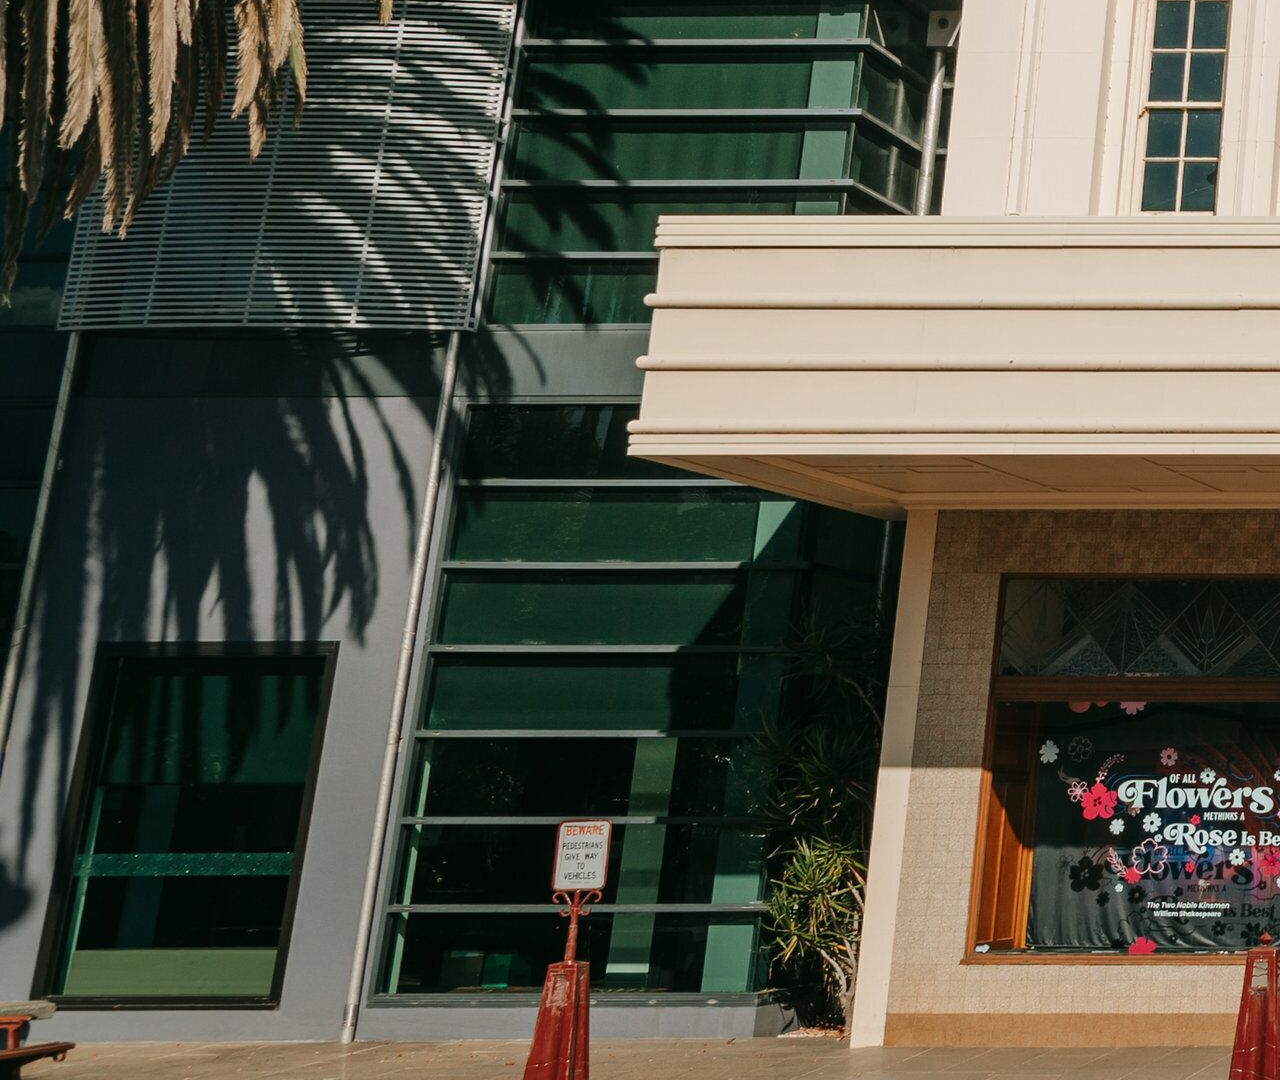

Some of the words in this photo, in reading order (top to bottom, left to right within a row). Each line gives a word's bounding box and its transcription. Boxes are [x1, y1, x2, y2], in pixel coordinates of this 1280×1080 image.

[1169, 774, 1180, 784] OF
[1182, 774, 1197, 784] ALL
[1117, 777, 1274, 814] Flowers
[1203, 812, 1238, 821] METHINKS
[1239, 812, 1245, 821] A
[566, 825, 605, 836] BEWARE
[1163, 823, 1237, 854] Rose
[1241, 831, 1256, 847] Is
[562, 841, 603, 851] PEDESTRIANS
[565, 853, 580, 861] GIVE
[585, 852, 599, 860] WAY
[577, 862, 586, 870] TO
[563, 871, 597, 880] VEHICLES
[1146, 901, 1160, 909] The
[1161, 901, 1176, 909] Two
